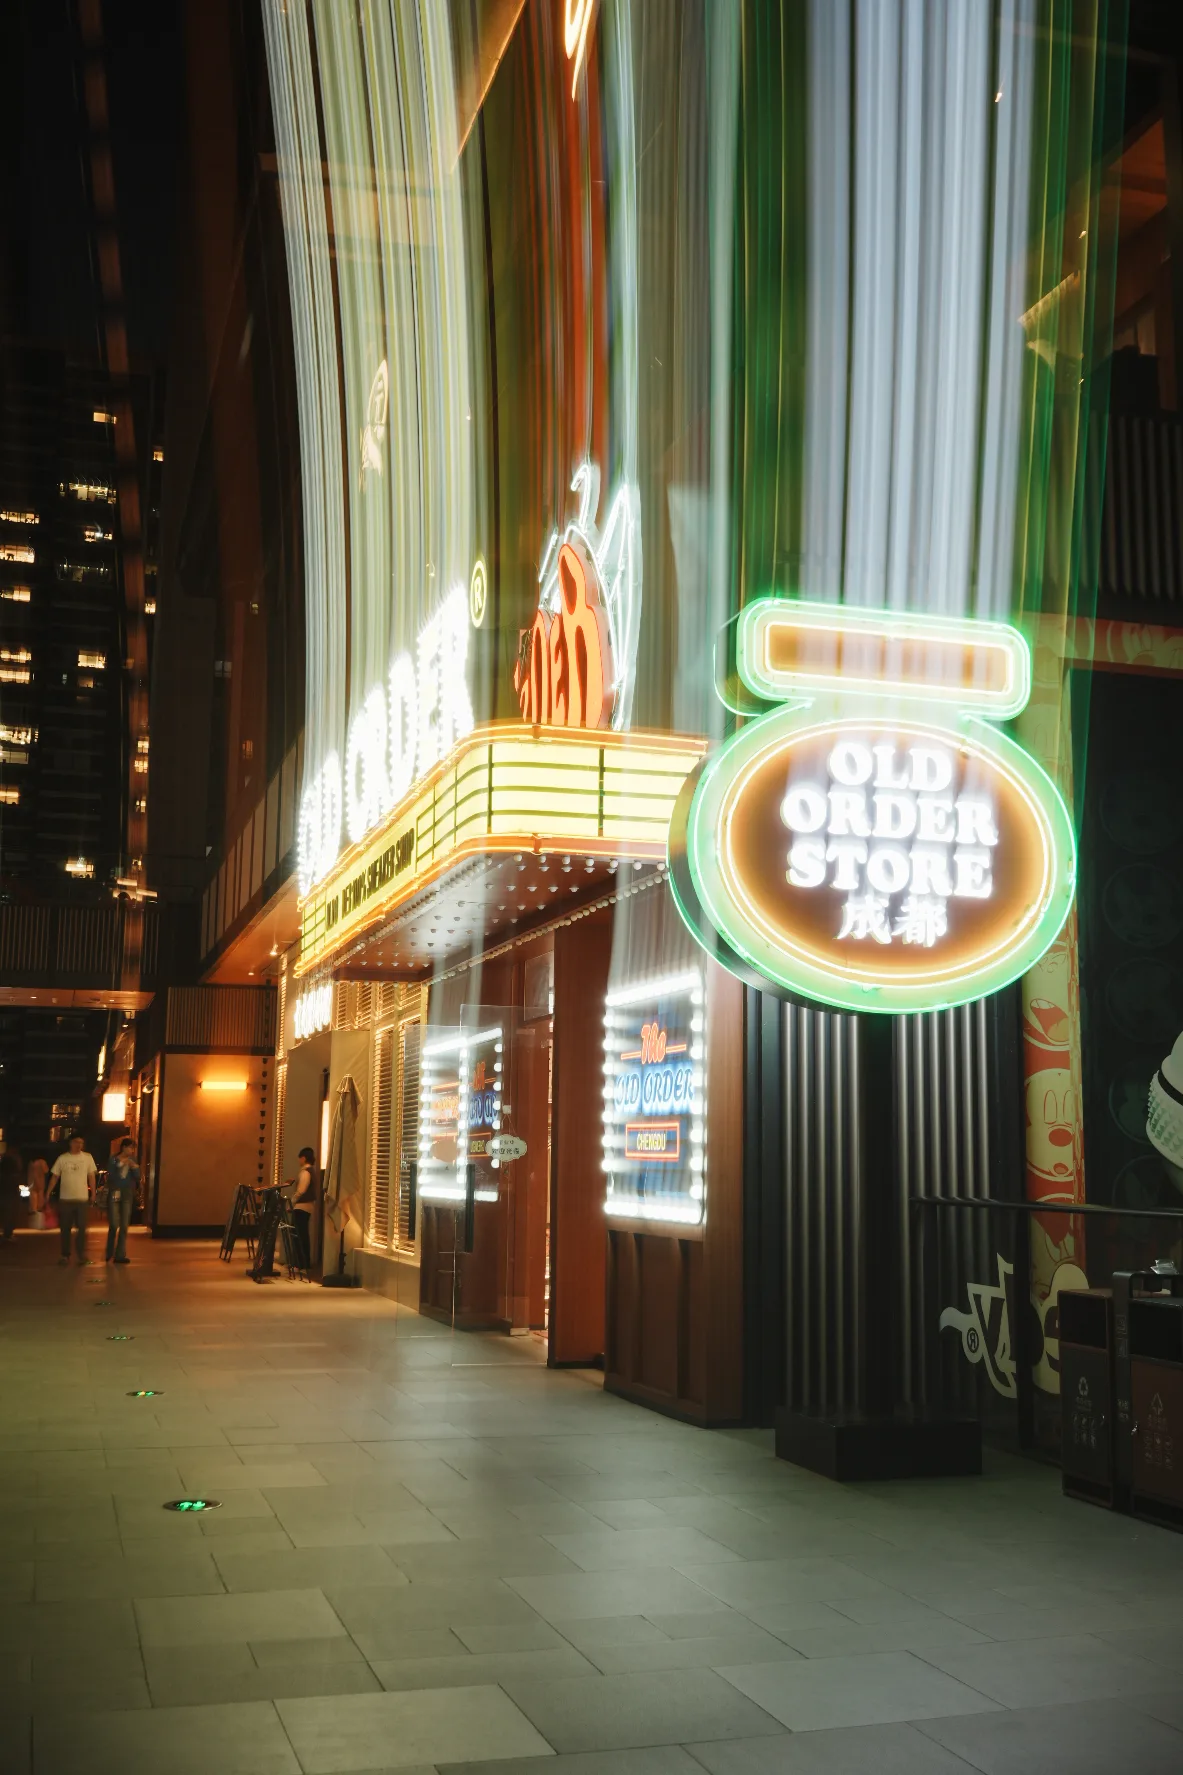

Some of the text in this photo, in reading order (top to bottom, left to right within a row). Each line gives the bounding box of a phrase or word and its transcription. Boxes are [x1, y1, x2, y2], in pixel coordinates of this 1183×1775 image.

[830, 743, 953, 792] OLD
[780, 787, 999, 846] ORDER
[786, 843, 993, 898] STORE
[832, 895, 948, 948] 成都
[641, 1022, 667, 1065] The
[615, 1067, 694, 1106] OLD ORDER
[636, 1131, 667, 1151] CHENGDU
